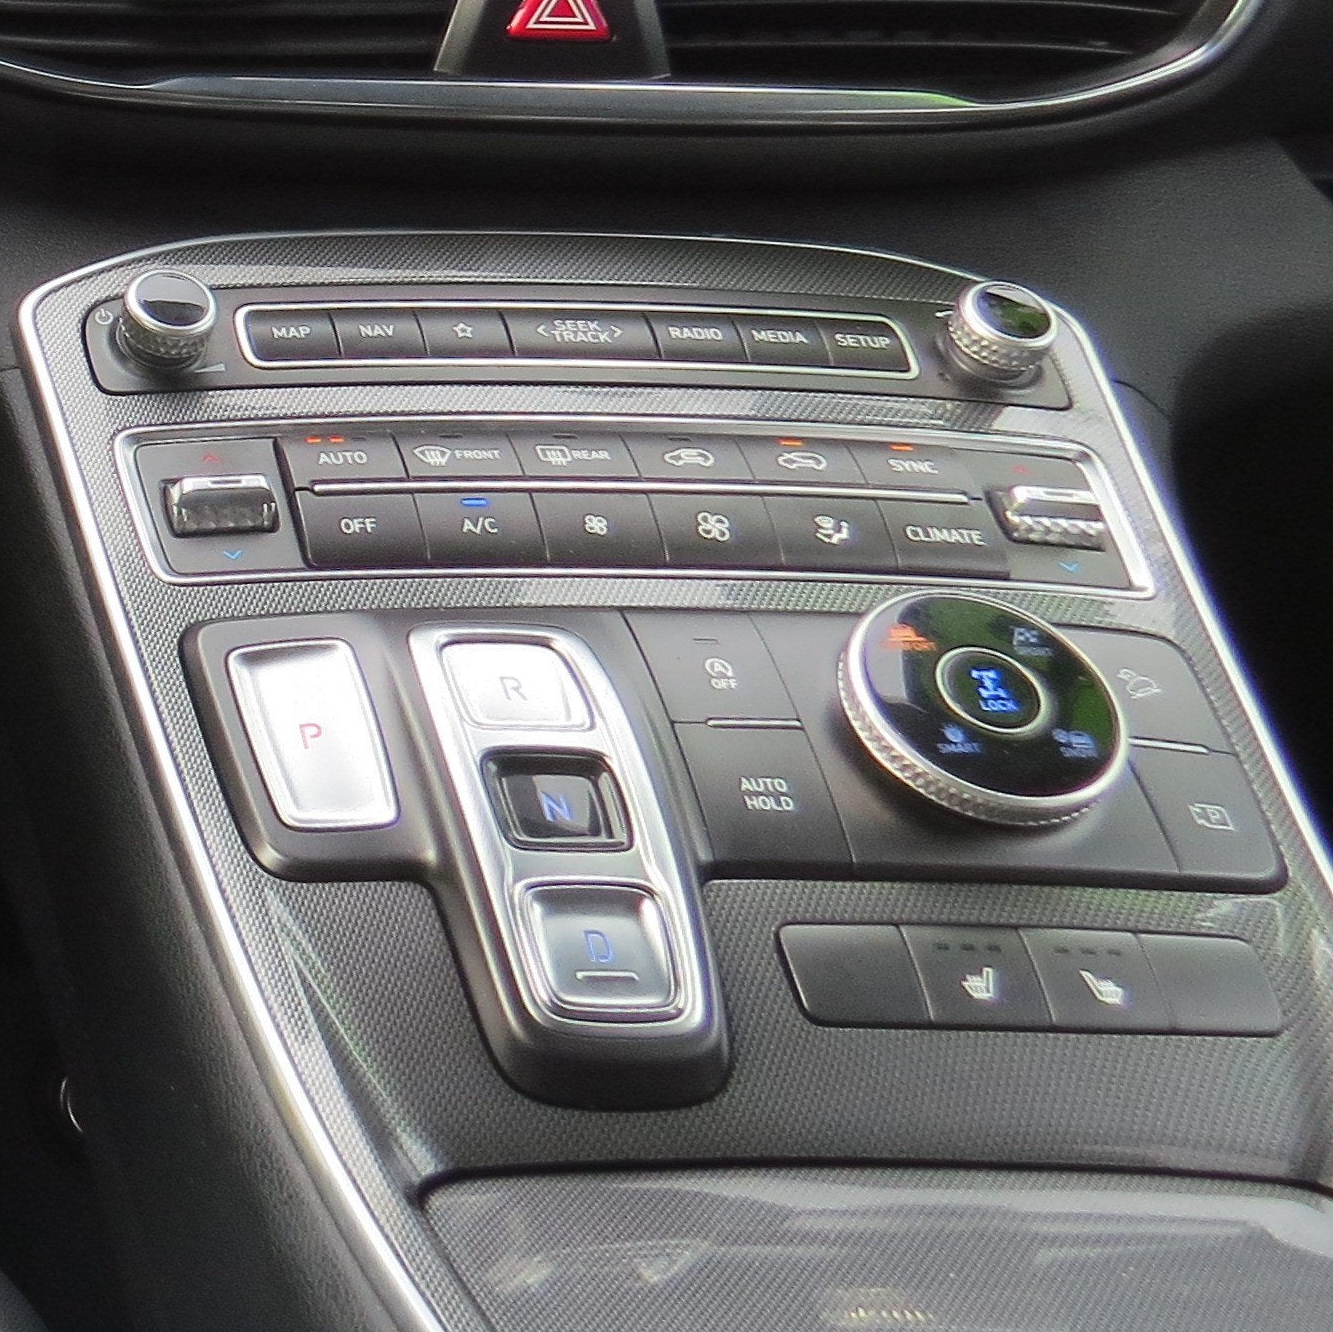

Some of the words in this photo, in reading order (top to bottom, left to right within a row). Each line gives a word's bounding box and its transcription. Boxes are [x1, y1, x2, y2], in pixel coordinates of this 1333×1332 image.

[271, 325, 311, 339] MAP
[359, 324, 394, 338] NAV
[554, 320, 600, 333] SEEK
[668, 326, 723, 341] RADIO
[554, 330, 610, 344] TRACK
[751, 328, 809, 344] MEDIA
[835, 333, 891, 349] SETUP
[317, 450, 368, 466] AUTO
[455, 448, 501, 463] FRONT
[572, 447, 610, 461] REAR
[887, 458, 939, 475] SYNC
[340, 516, 377, 533] OFF
[462, 515, 498, 533] A/C
[906, 524, 987, 547] CLIMATE
[499, 675, 525, 701] R
[710, 678, 738, 689] OFF
[980, 699, 1019, 711] LOCK
[299, 722, 322, 750] P
[740, 777, 787, 792] AUTO
[540, 793, 572, 823] N
[744, 795, 794, 811] HOLD
[584, 929, 615, 962] D
